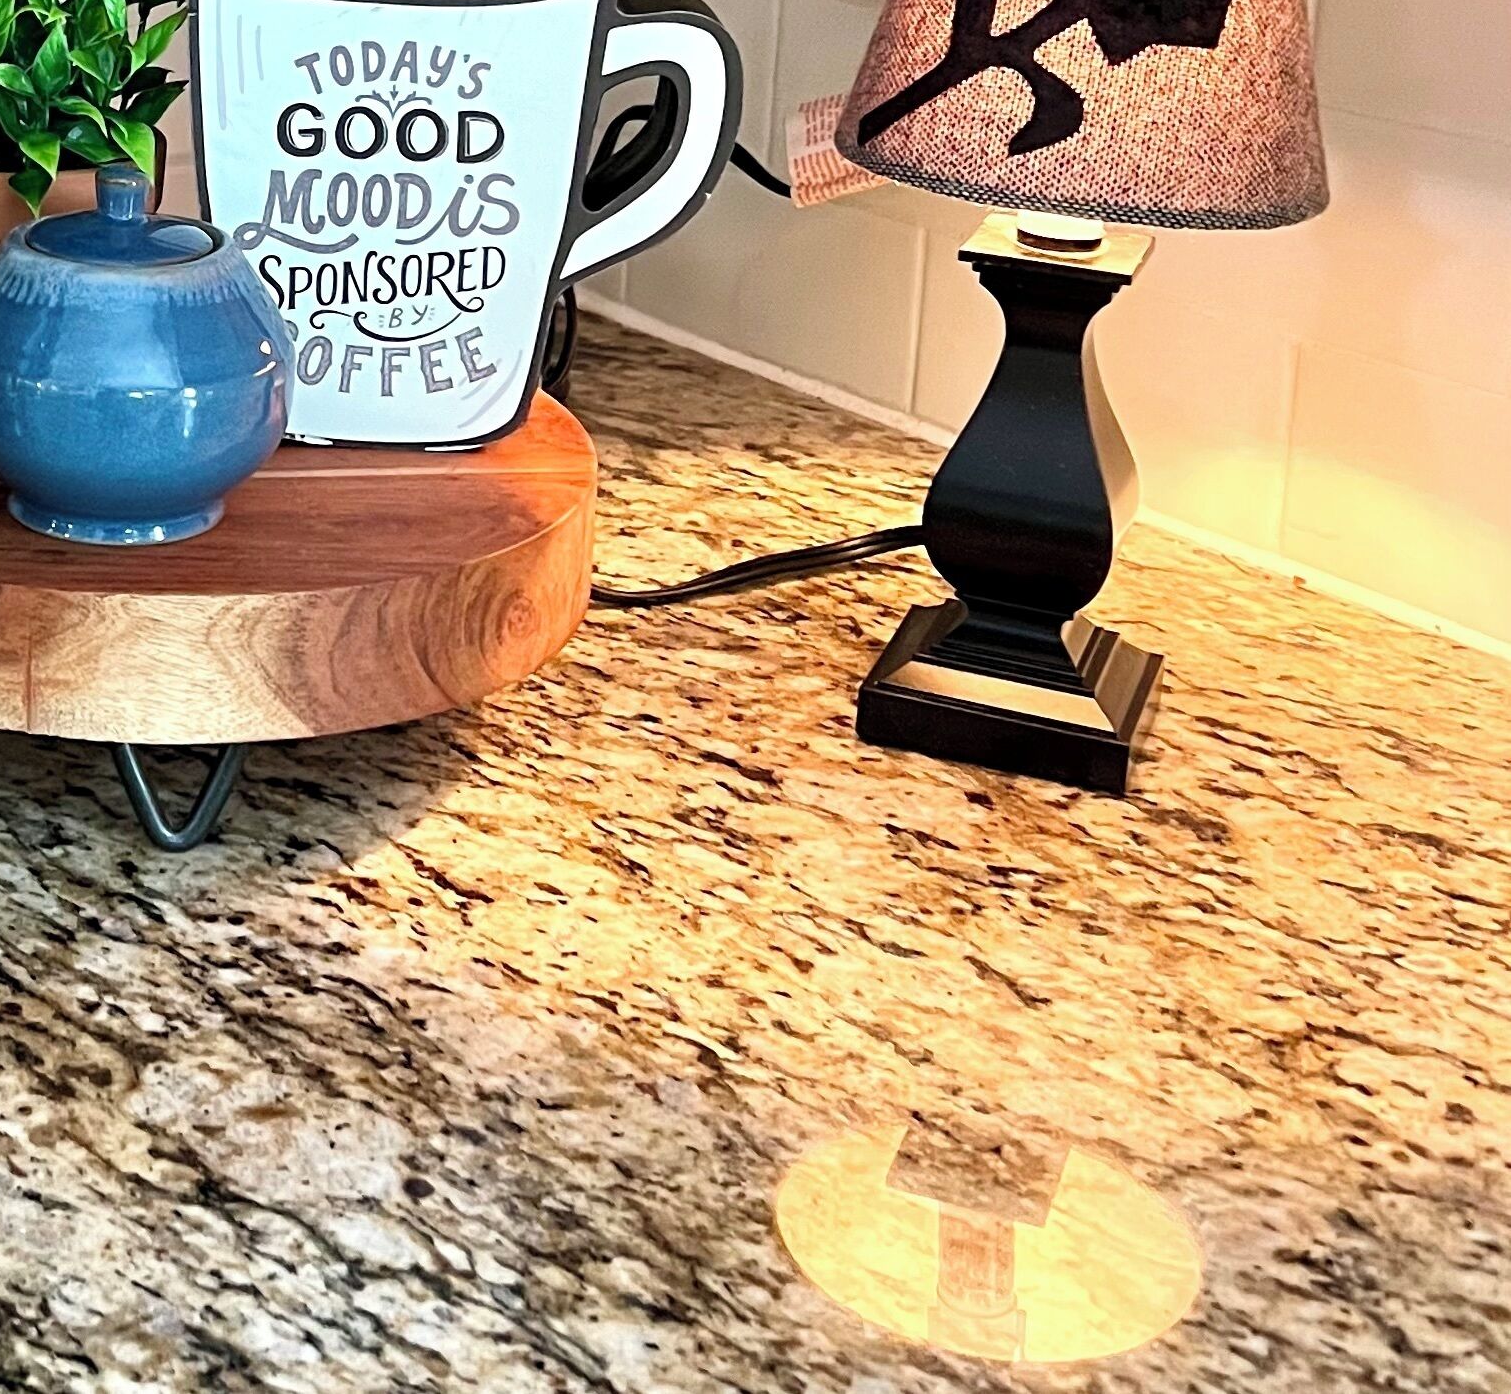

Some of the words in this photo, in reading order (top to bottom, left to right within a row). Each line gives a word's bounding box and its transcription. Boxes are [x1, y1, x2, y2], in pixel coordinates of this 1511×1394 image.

[294, 40, 492, 99] TODAY'S
[277, 103, 505, 163] GOOD
[233, 169, 432, 254] MOOD
[259, 246, 506, 313] SPONSORED
[388, 305, 429, 329] BY
[285, 320, 498, 398] OFFEE
